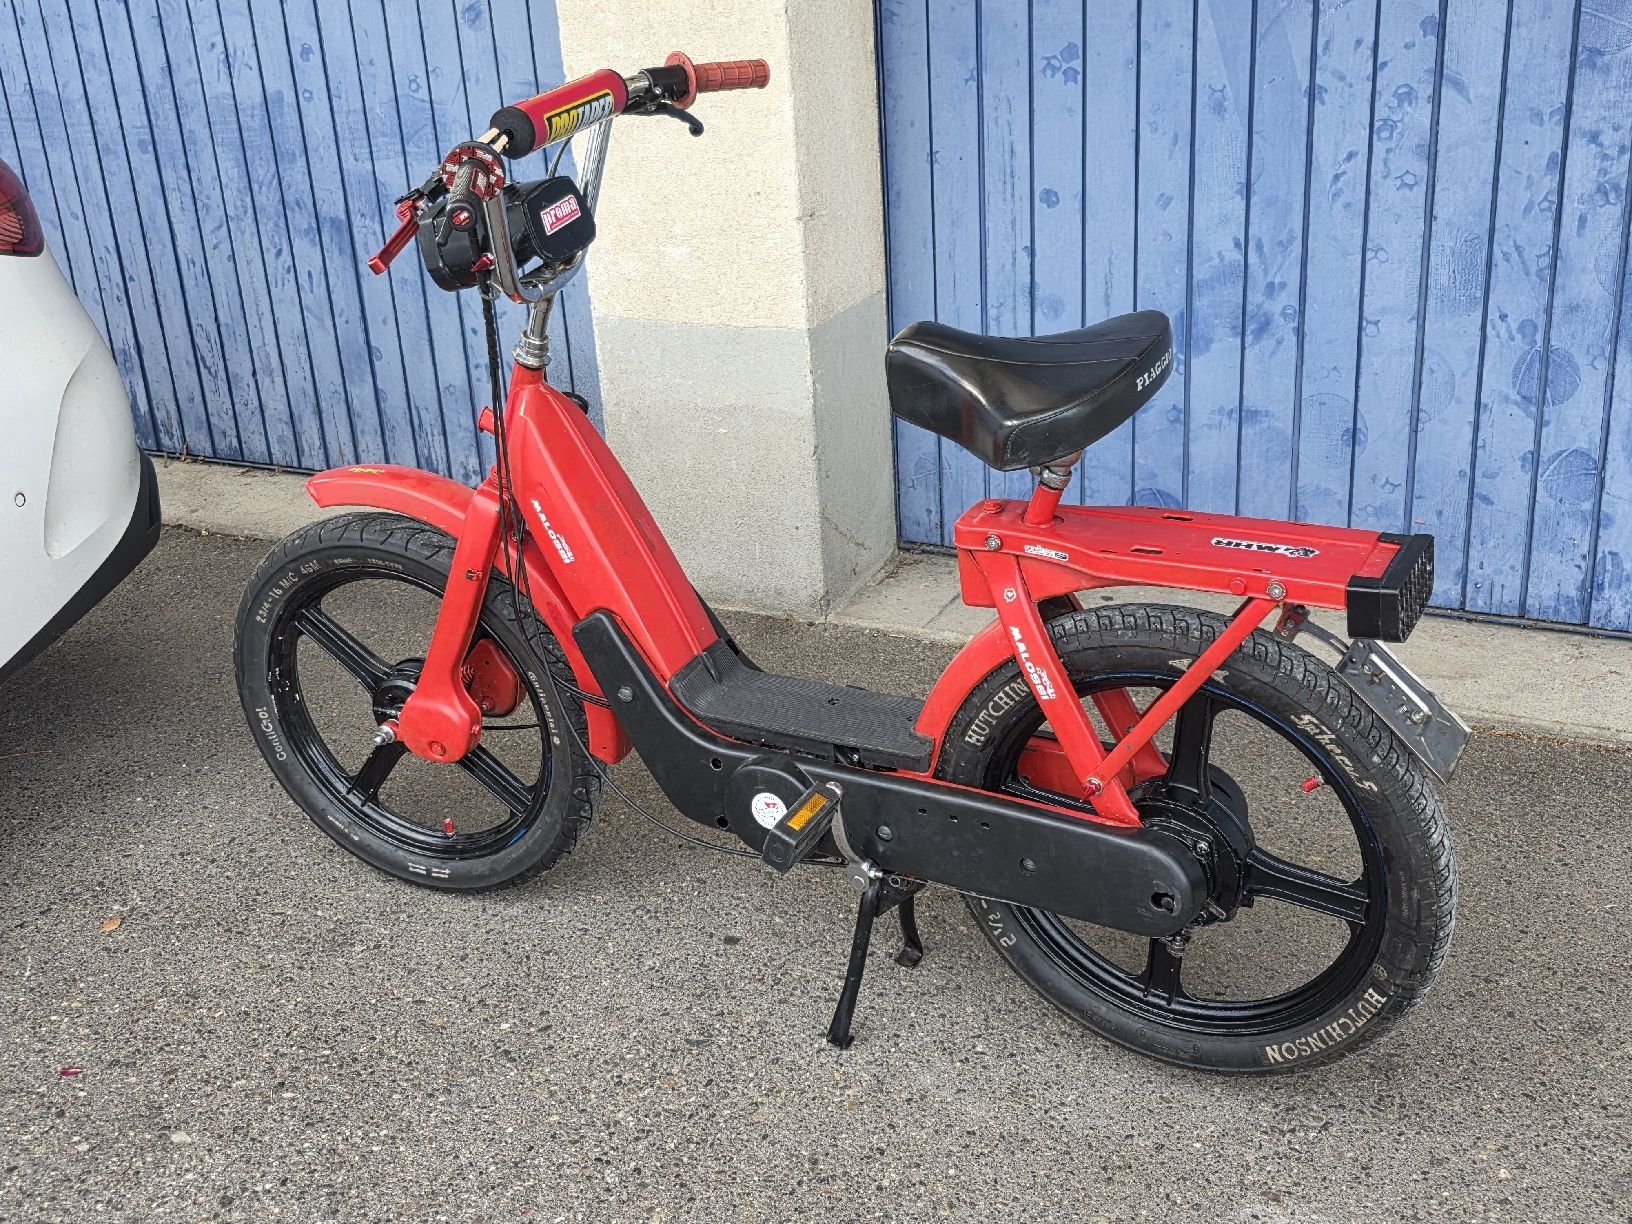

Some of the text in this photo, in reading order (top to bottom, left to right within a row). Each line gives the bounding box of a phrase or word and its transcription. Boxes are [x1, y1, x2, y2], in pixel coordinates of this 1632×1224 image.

[531, 499, 571, 564] MALOSSI
[1009, 626, 1051, 700] MALOSSI
[1265, 987, 1388, 1064] HUTCHINSON
